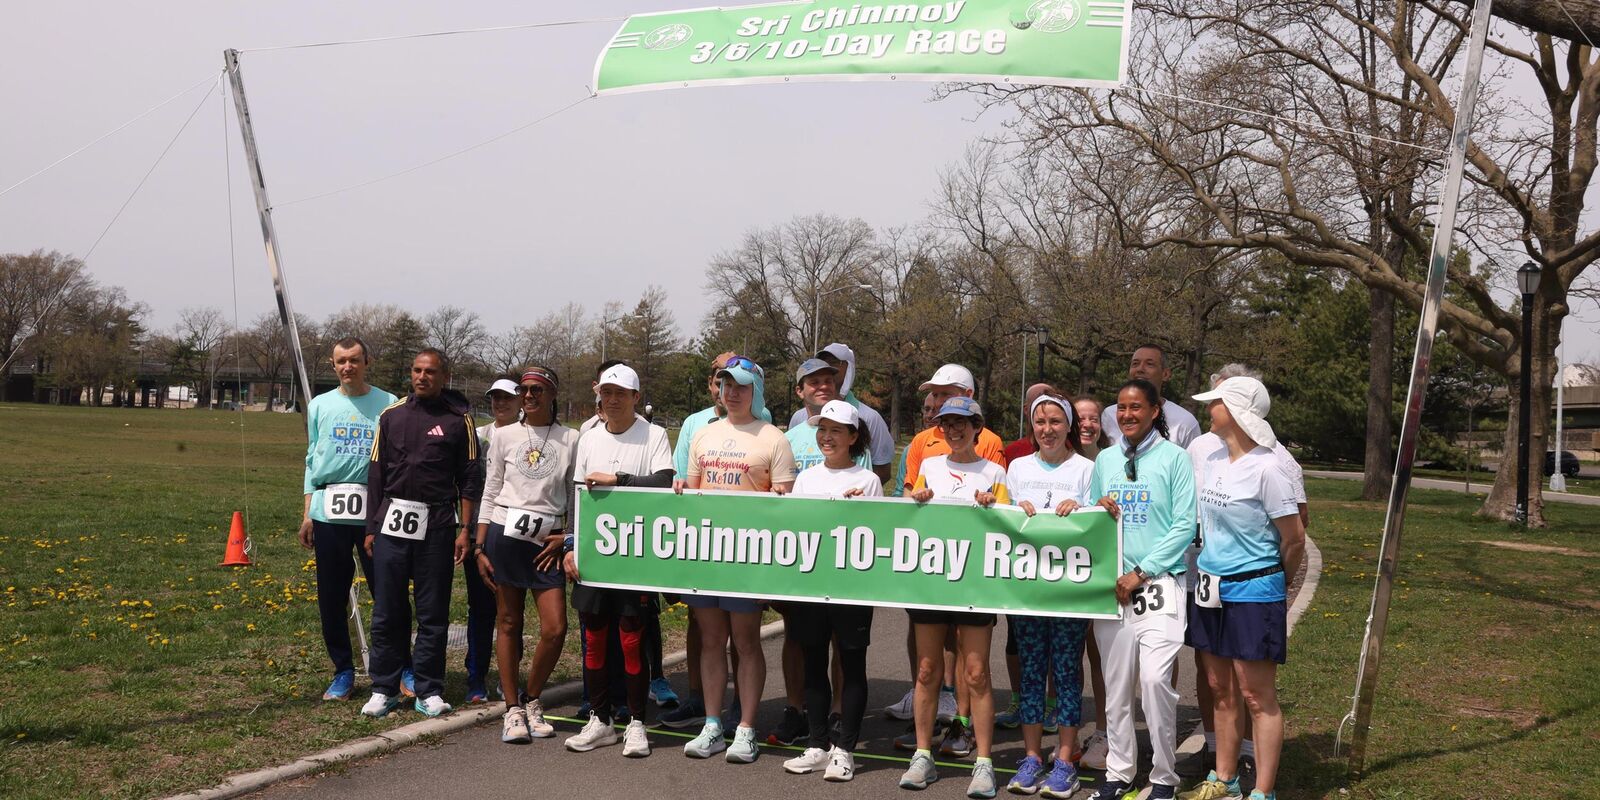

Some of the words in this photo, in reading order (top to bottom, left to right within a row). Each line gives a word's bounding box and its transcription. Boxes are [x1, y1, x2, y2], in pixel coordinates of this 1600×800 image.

[736, 15, 792, 37] Sri
[800, 0, 967, 33] Chinmoy
[689, 33, 895, 64] 3/6/10-Day
[904, 28, 1007, 55] Race
[335, 428, 347, 437] 10
[335, 446, 371, 456] RACES
[706, 449, 717, 457] SRI
[719, 450, 746, 458] CHINMOY
[697, 454, 750, 474] Thanksgiving
[331, 493, 362, 516] 50
[1141, 491, 1148, 502] 3
[1206, 489, 1232, 500] CHINMOY
[389, 509, 419, 535] 36
[514, 514, 543, 538] 41
[1123, 513, 1148, 523] CES
[595, 513, 645, 557] Sri
[652, 516, 822, 573] Chinmoy
[830, 525, 971, 582] 10-Day
[983, 532, 1093, 583] Race
[1131, 583, 1165, 616] 53
